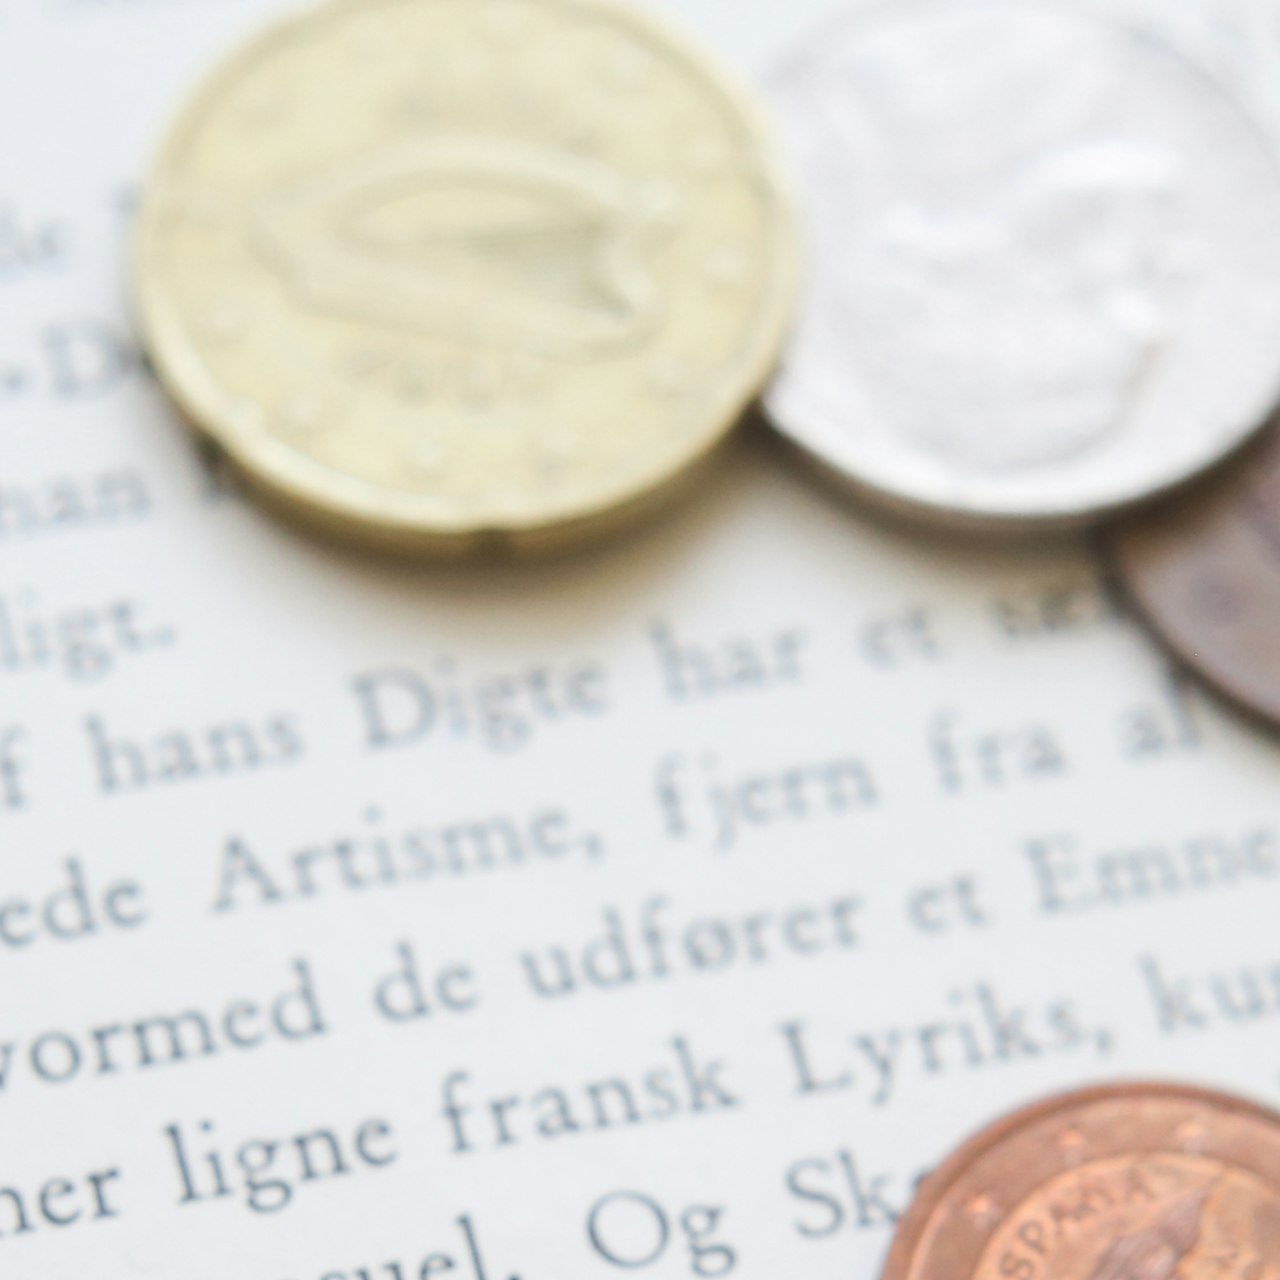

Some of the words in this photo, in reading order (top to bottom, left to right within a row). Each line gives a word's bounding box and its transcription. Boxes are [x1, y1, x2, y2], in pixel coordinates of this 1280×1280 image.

[82, 708, 305, 798] hans
[350, 655, 604, 751] Digte
[652, 620, 804, 703] har
[860, 612, 940, 674] et
[210, 804, 605, 916] Artisme,
[654, 752, 883, 856] fjern
[927, 710, 1068, 795] fra
[372, 940, 477, 1024] de
[518, 895, 861, 1000] udfører
[906, 873, 989, 936] et
[163, 1119, 395, 1214] ligne
[441, 1034, 741, 1154] fransk
[778, 982, 1111, 1106] Lyriks,
[585, 1192, 738, 1278] Og
